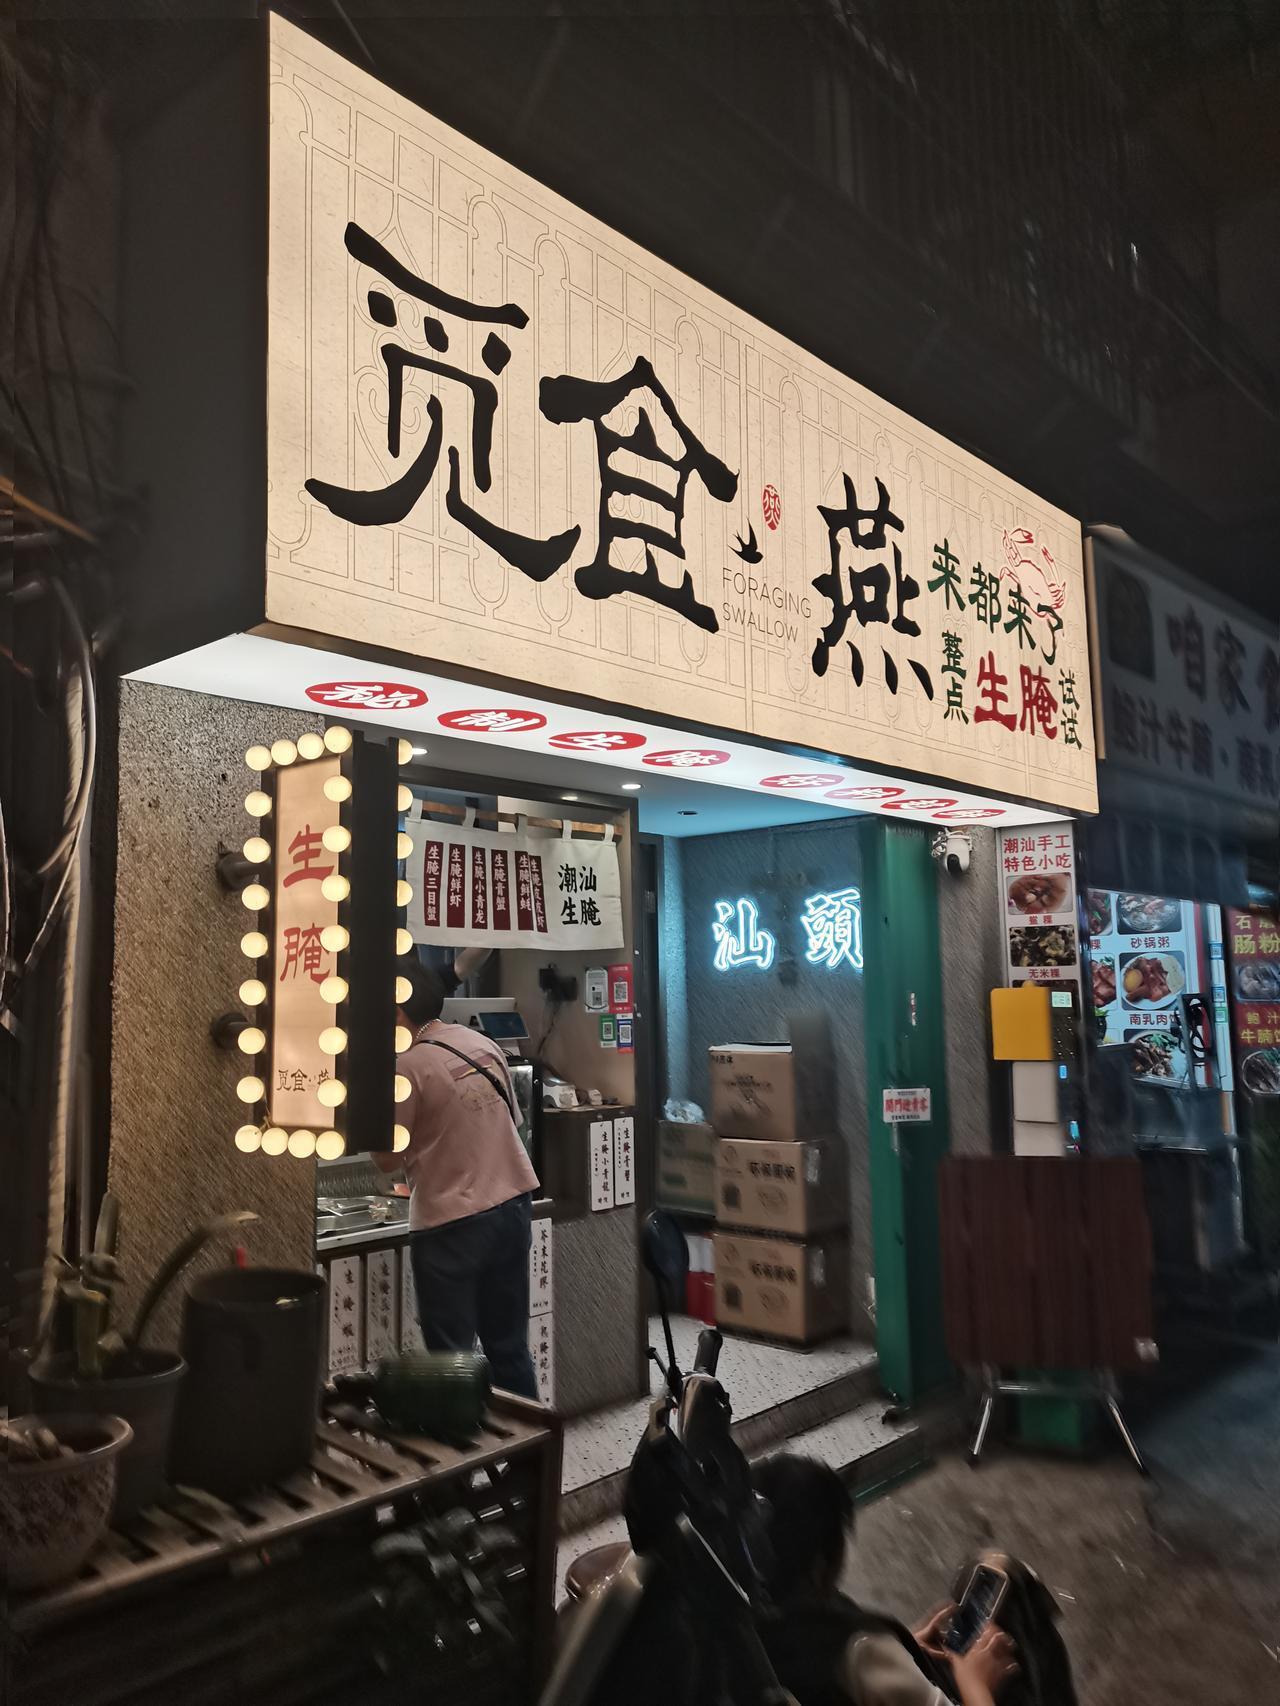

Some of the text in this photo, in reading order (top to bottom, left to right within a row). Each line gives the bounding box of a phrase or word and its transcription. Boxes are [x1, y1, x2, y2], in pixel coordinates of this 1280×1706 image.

[722, 567, 812, 618] FORAGING
[812, 472, 933, 701] 燕
[927, 537, 1064, 665] 来都来了
[722, 604, 798, 642] SWALLOW
[973, 650, 1058, 740] 生腌
[1003, 835, 1071, 854] 潮汕手工
[1004, 853, 1072, 873] 特色小吃
[426, 845, 440, 921] 生腌三目蟹
[450, 848, 463, 908] 生腌鲜虾
[474, 850, 486, 924] 生腌小青龙
[557, 863, 597, 894] 潮汕
[279, 824, 335, 985] 生腌
[560, 896, 602, 926] 生腌
[1130, 936, 1171, 950] 砂锅粥
[1234, 932, 1280, 954] 肠粉
